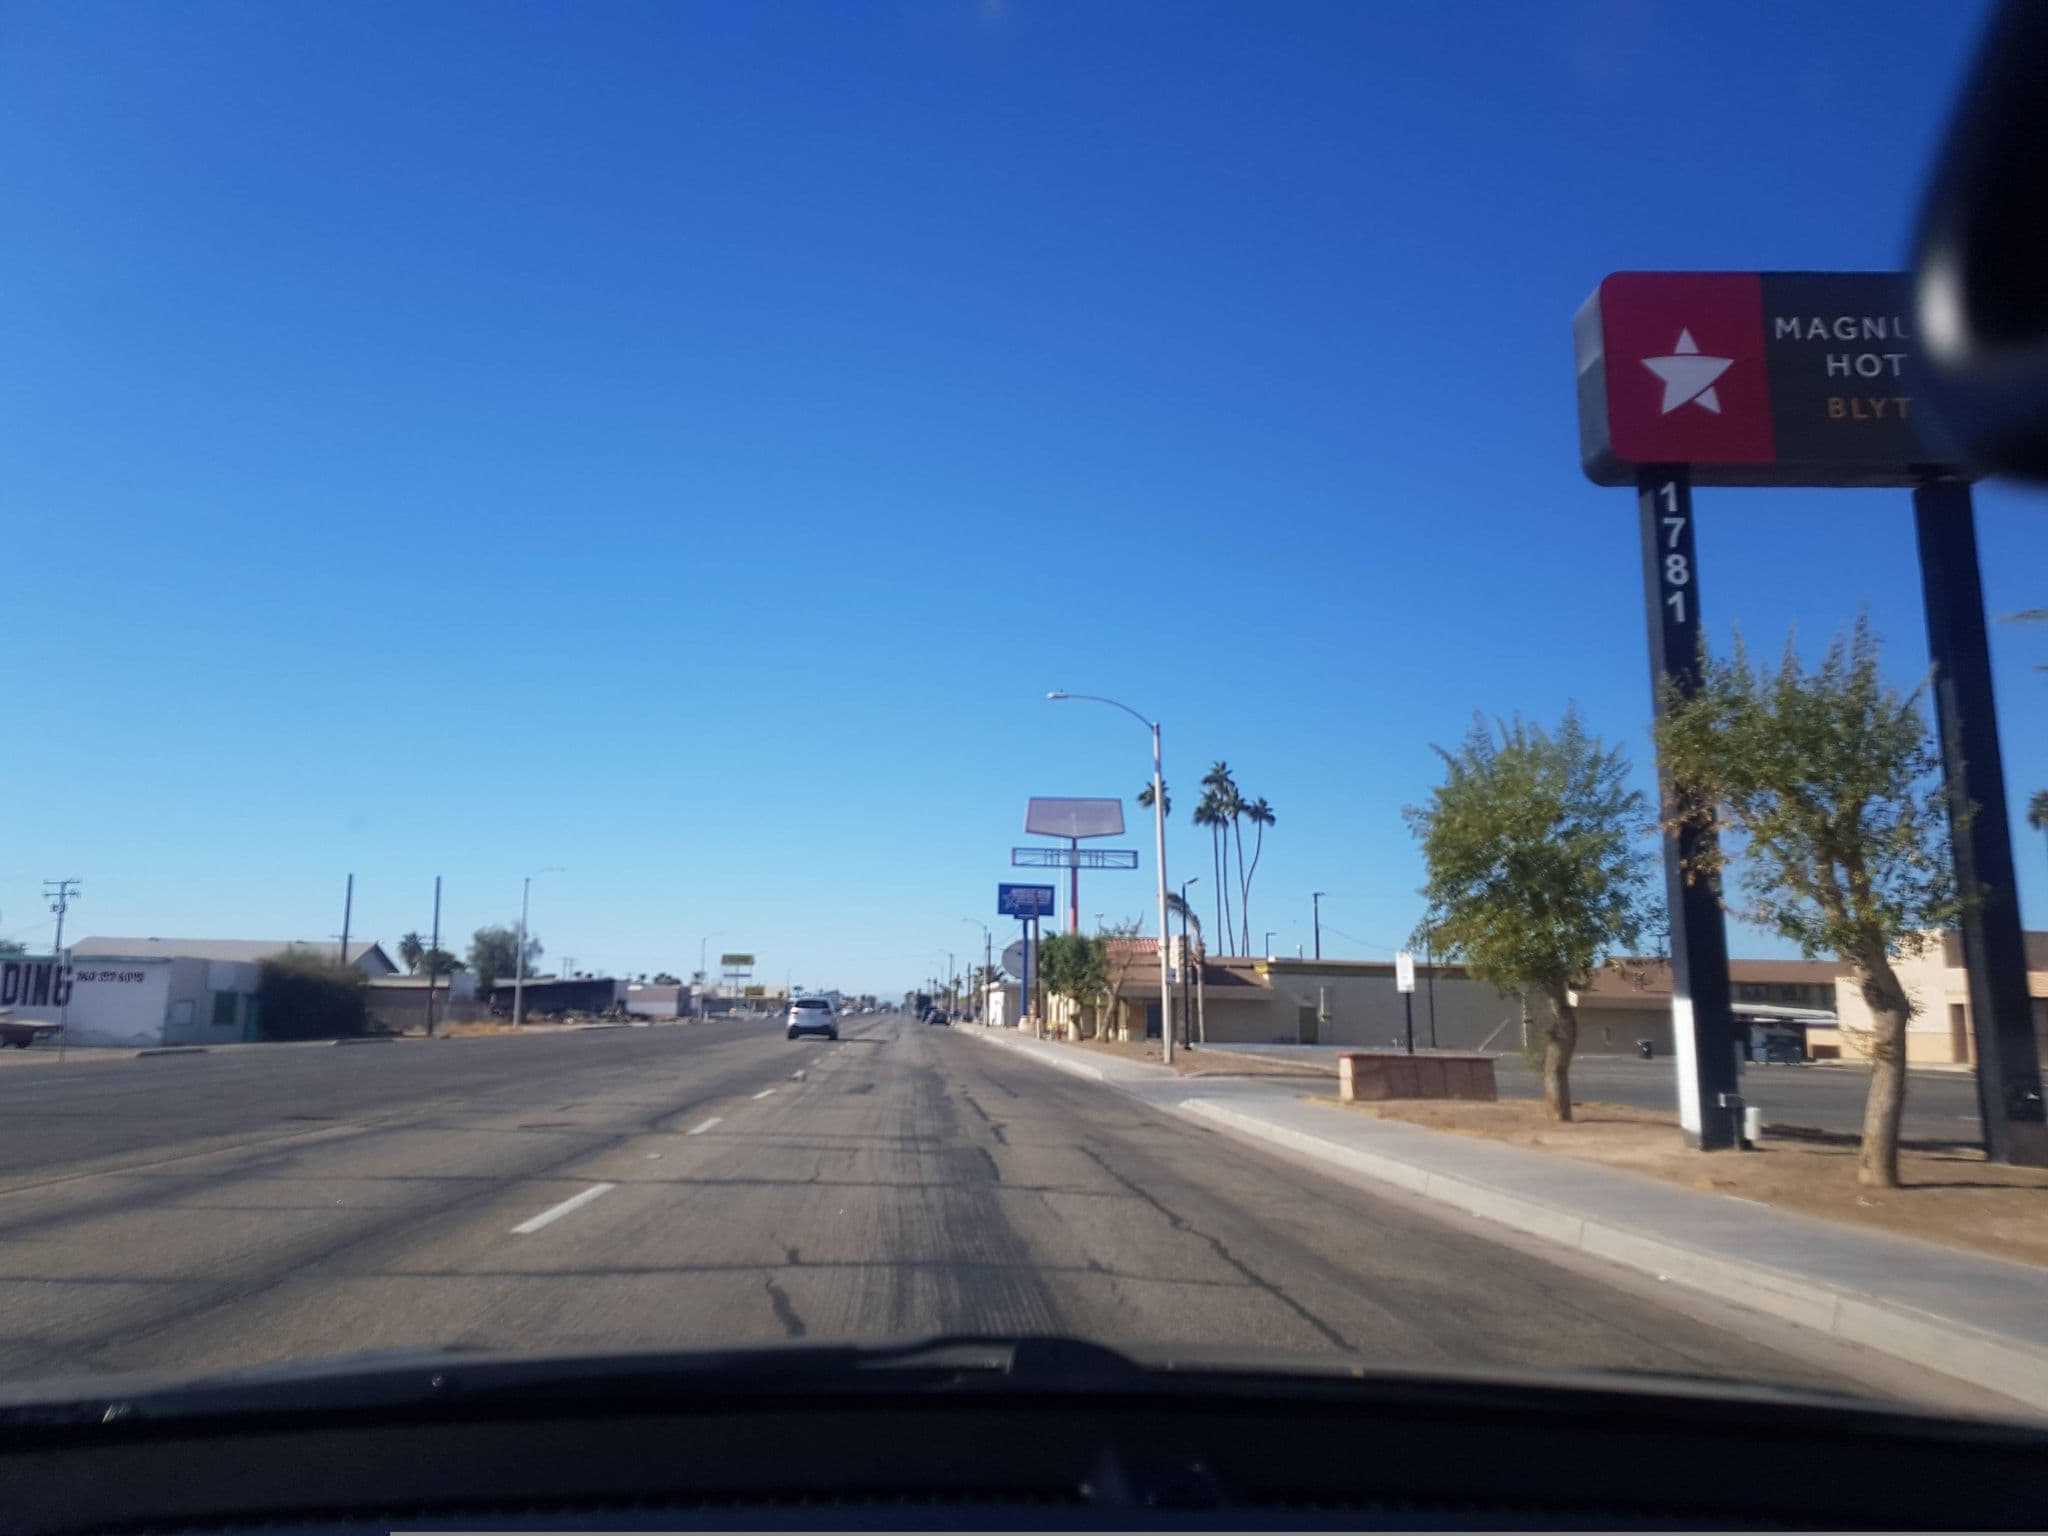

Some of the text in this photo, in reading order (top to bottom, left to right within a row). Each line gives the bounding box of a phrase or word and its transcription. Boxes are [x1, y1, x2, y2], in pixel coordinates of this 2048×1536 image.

[1826, 353, 1908, 378] HOT
[1827, 396, 1913, 419] BLYT
[1659, 481, 1690, 623] 1781
[0, 962, 73, 1006] DING
